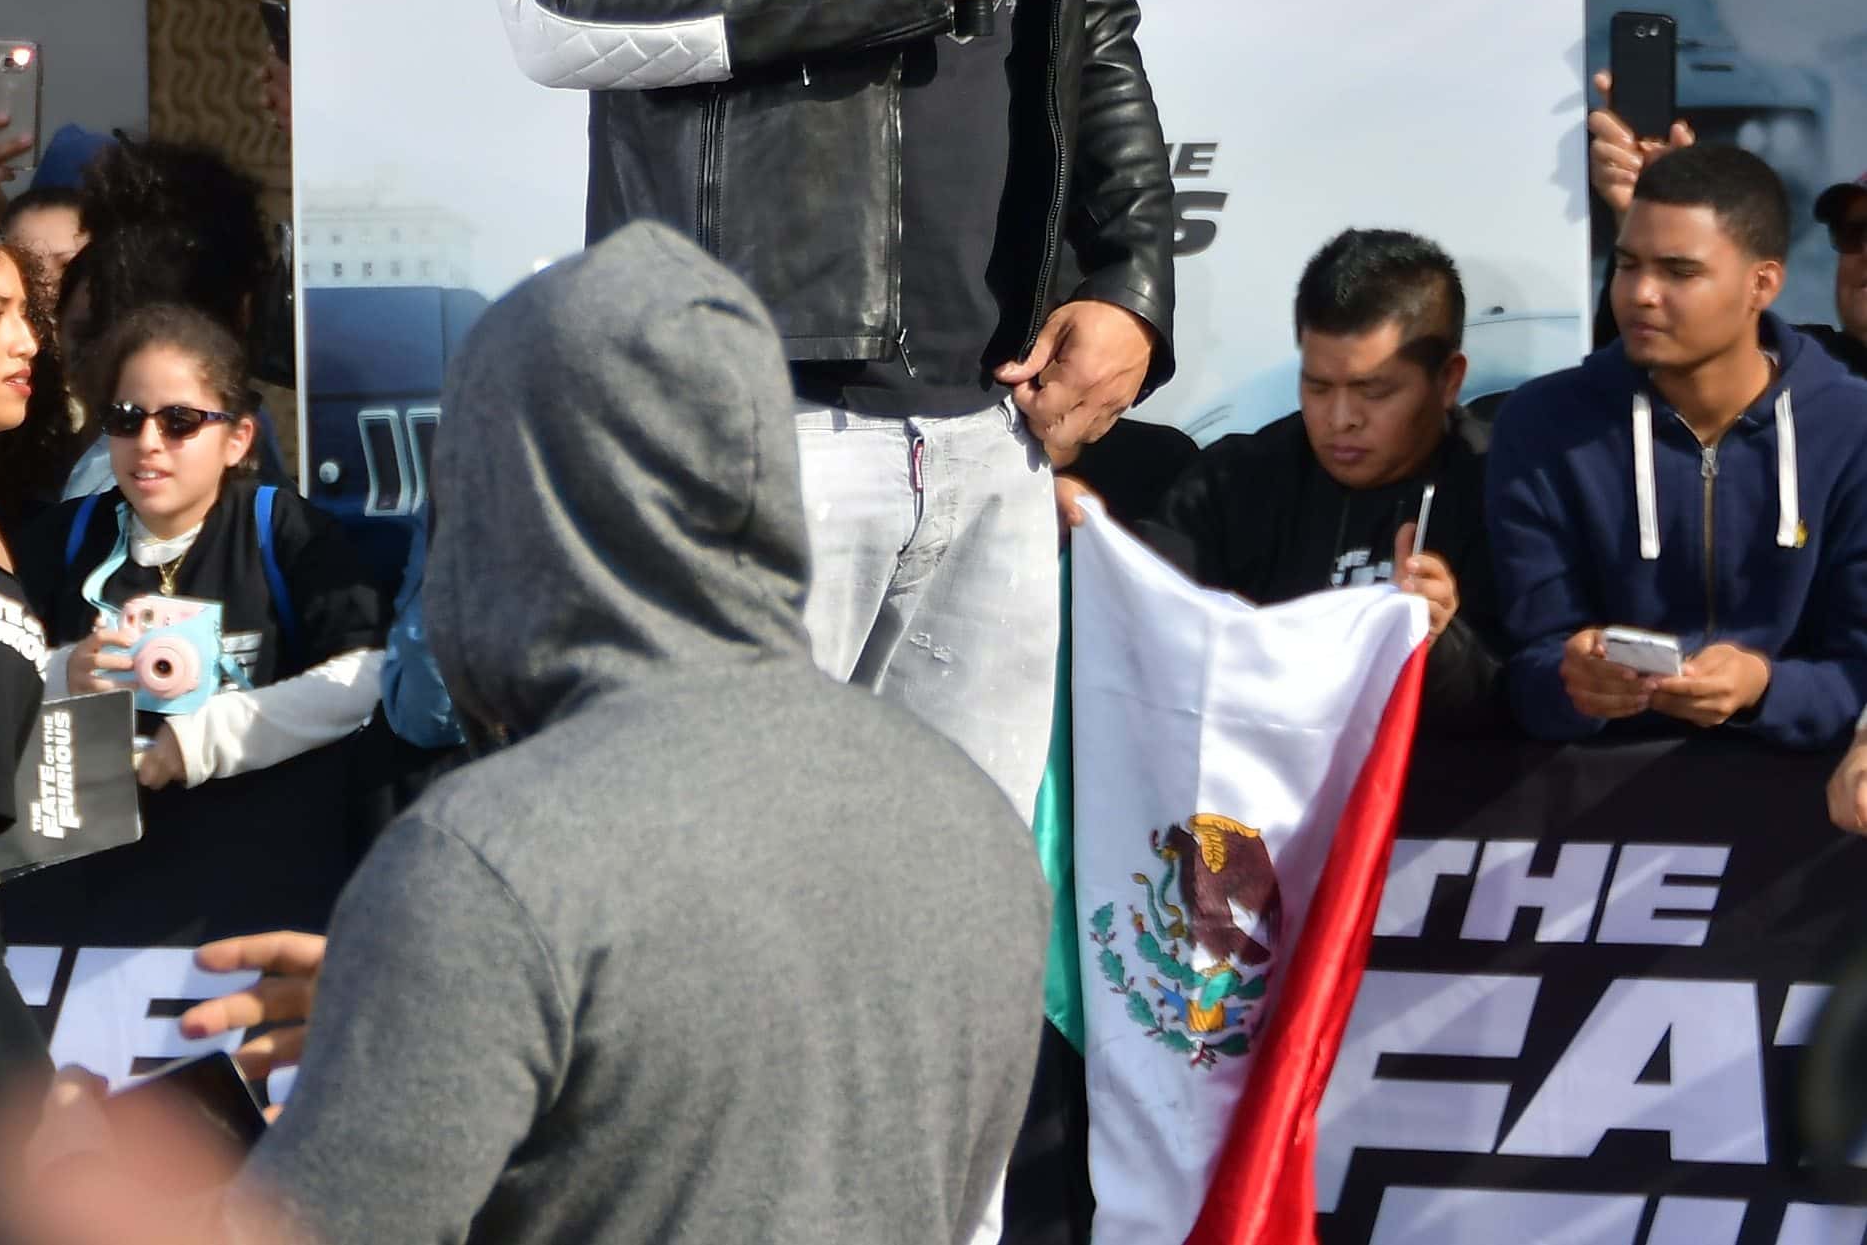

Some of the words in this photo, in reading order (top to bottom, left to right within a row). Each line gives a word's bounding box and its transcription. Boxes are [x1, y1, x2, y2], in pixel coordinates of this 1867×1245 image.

[42, 714, 55, 744] THE
[53, 711, 81, 830] FURIOUS
[37, 763, 65, 840] FATE
[1372, 838, 1733, 947] THE
[1314, 969, 1849, 1214] FA
